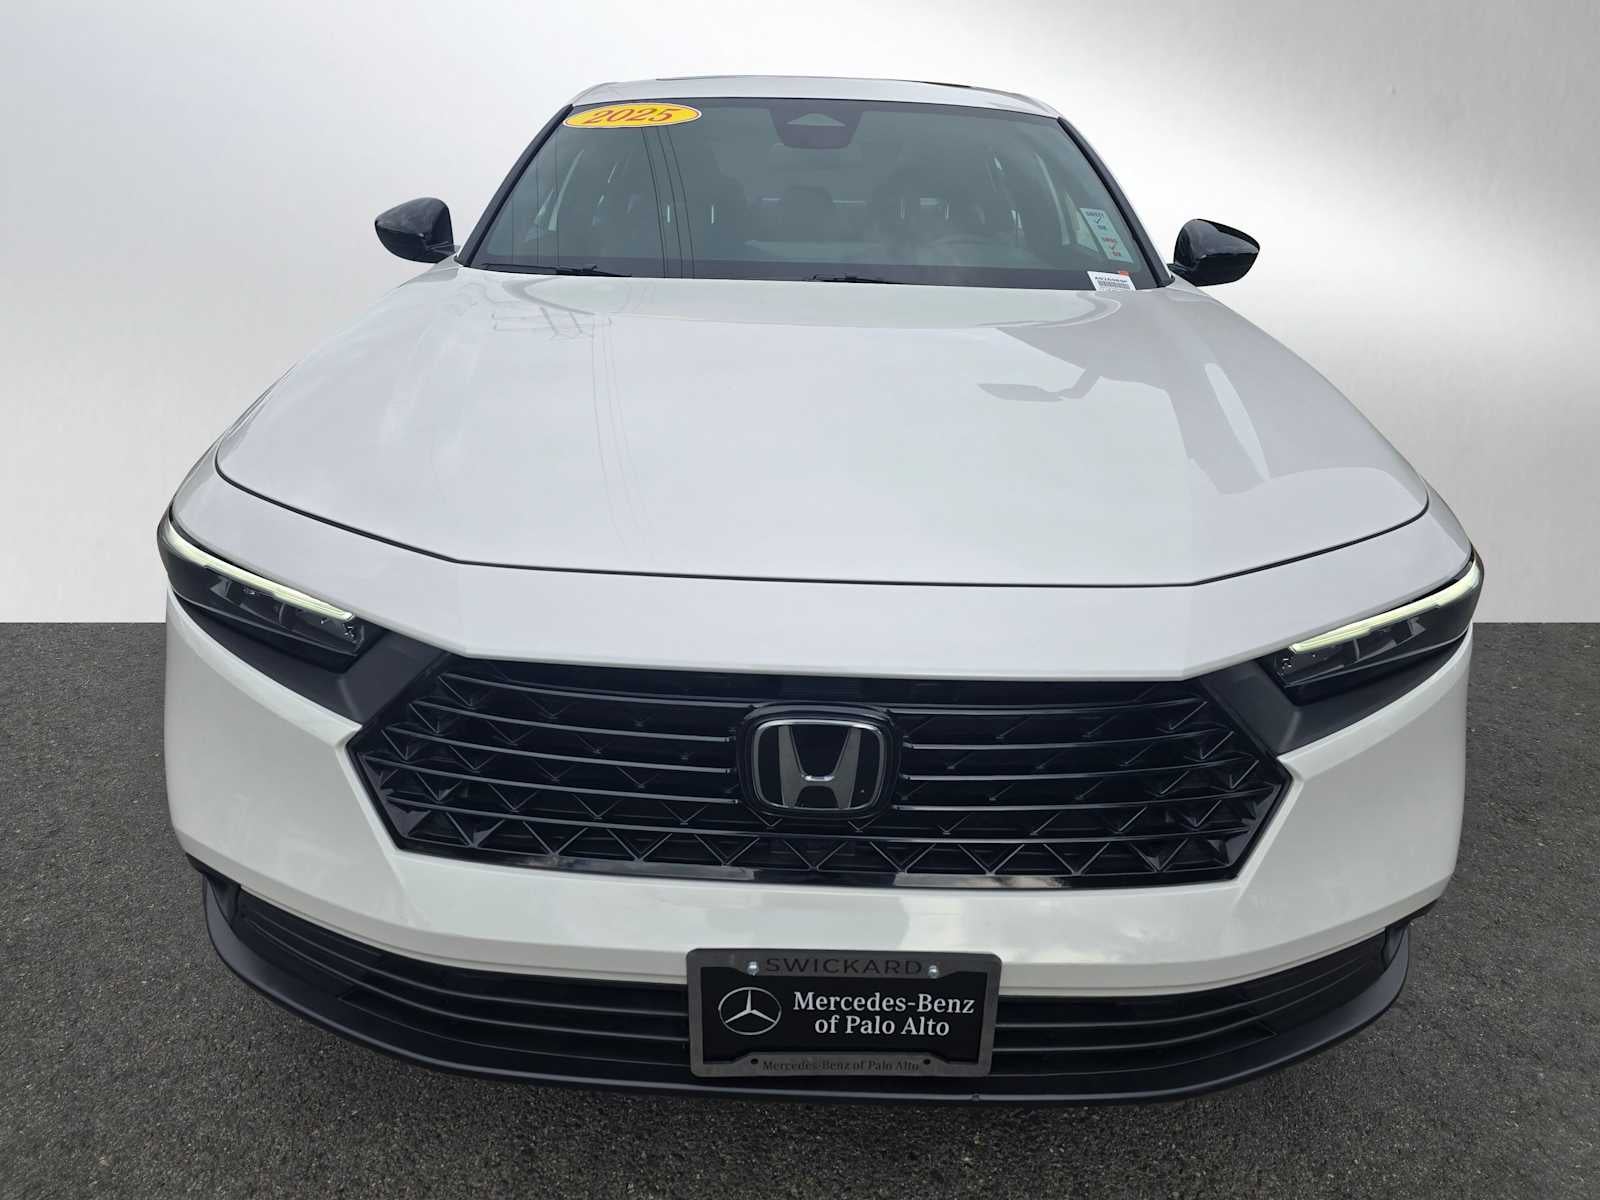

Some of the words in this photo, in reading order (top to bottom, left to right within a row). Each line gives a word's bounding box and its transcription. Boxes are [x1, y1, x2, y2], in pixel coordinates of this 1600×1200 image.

[583, 108, 680, 125] 2025
[766, 957, 922, 975] SWICKARD
[793, 991, 976, 1014] Mercedes-Benz
[814, 1014, 840, 1034] of
[845, 1015, 896, 1034] Palo
[900, 1016, 950, 1036] Alto
[762, 1059, 850, 1072] Mercedes-Benz
[852, 1059, 865, 1070] of
[867, 1059, 893, 1071] Palo
[895, 1059, 920, 1071] Alto
